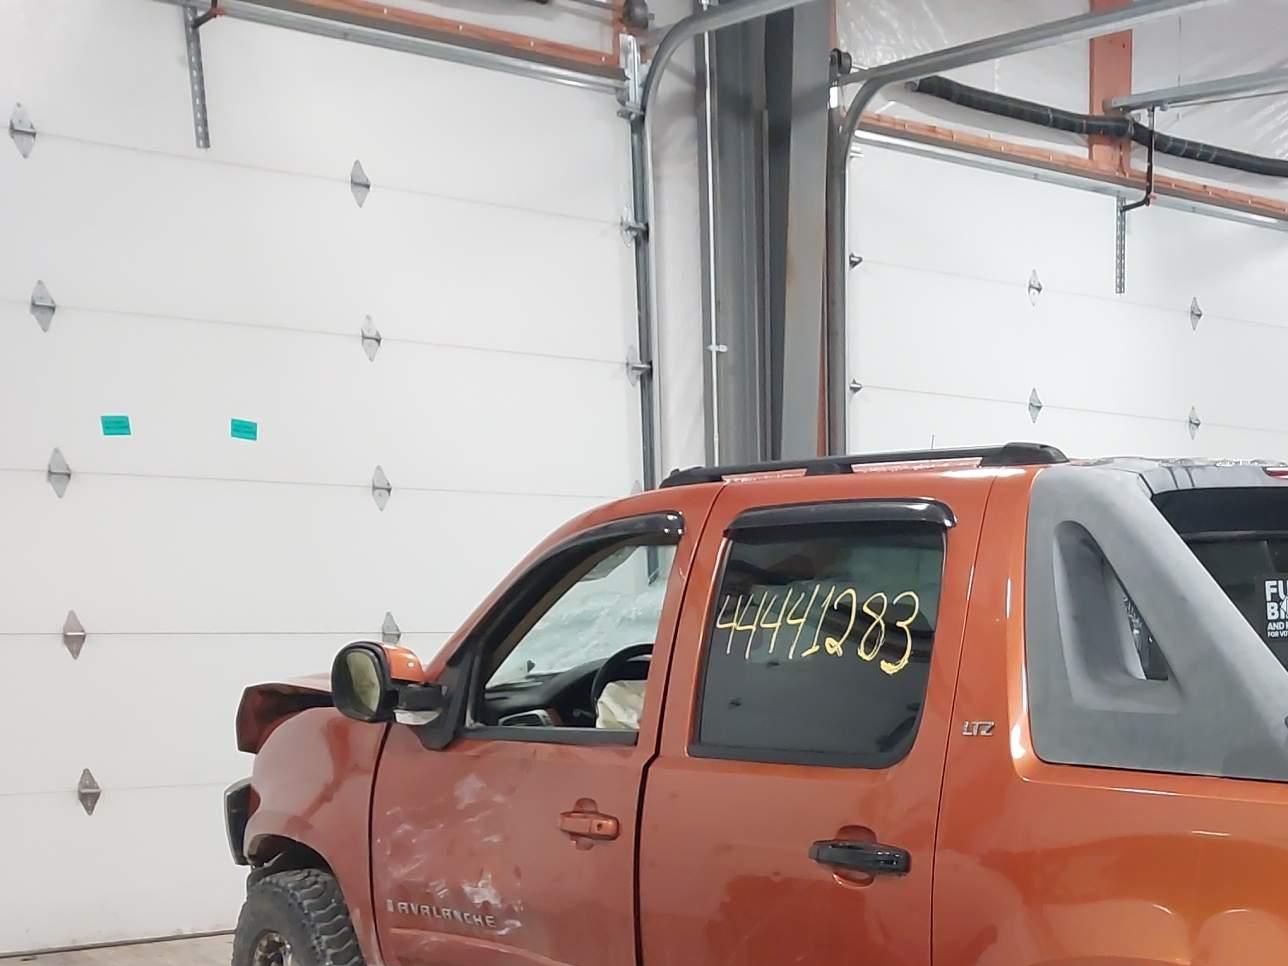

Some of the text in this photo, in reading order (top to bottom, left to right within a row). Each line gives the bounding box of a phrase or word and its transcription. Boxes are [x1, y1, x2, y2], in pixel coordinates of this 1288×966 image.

[716, 583, 920, 675] 44441283
[1267, 621, 1285, 631] AND
[962, 720, 995, 737] LTZ
[397, 901, 497, 928] AVALANCHE
